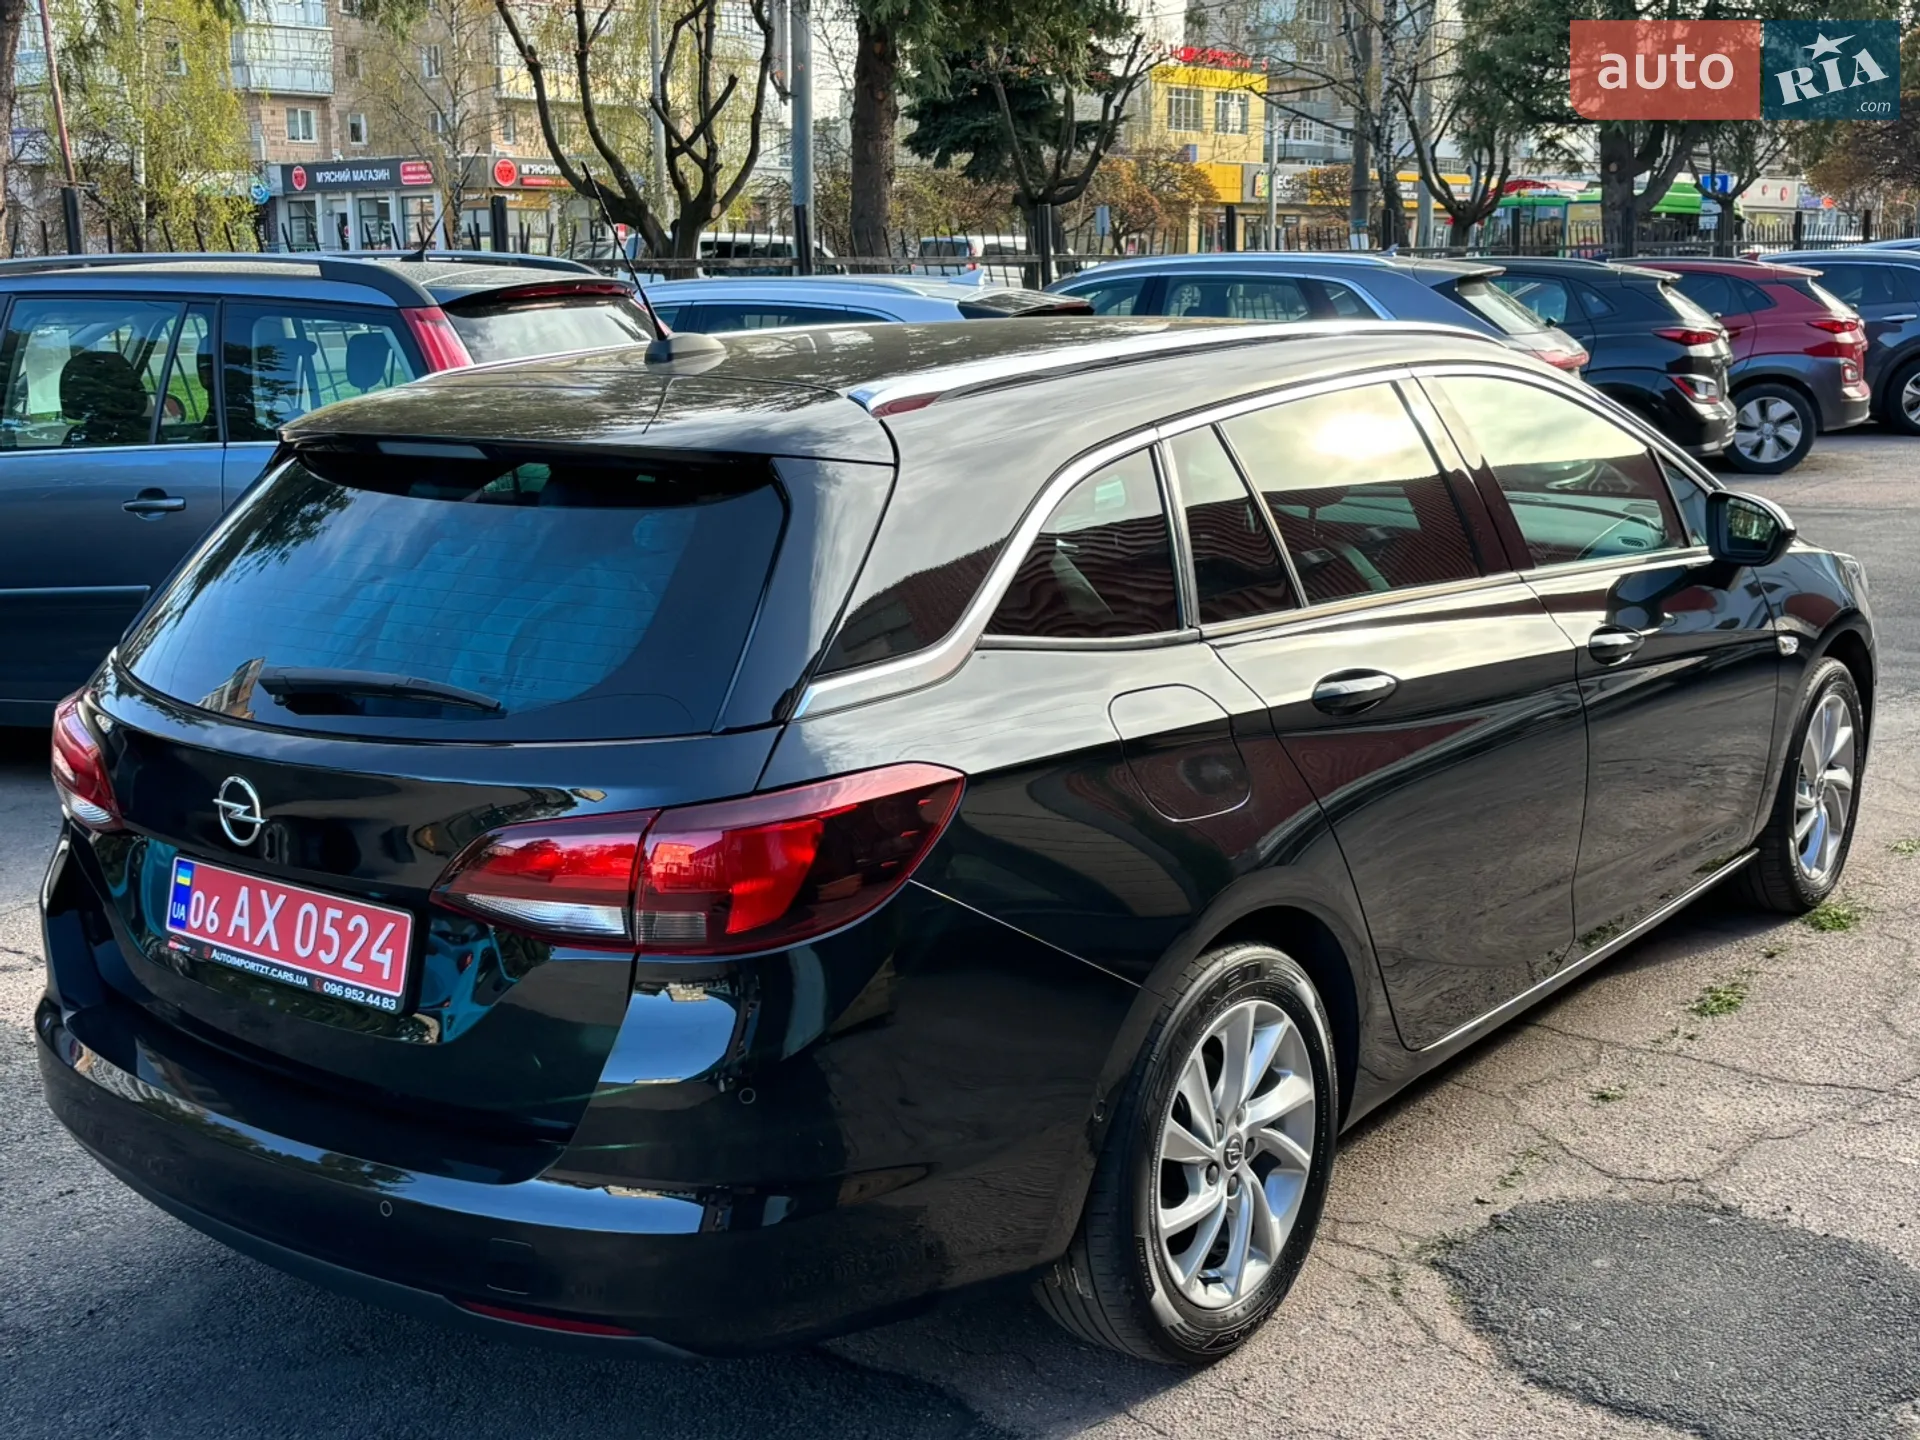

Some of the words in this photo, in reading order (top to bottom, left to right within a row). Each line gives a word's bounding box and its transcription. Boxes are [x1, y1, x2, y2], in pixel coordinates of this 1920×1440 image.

[316, 168, 351, 183] М'ЯСНИЙ
[352, 168, 390, 182] МАГАЗИН
[521, 164, 562, 175] М'ЯСНИ
[172, 901, 186, 921] UA
[189, 890, 220, 934] 06
[226, 885, 287, 952] AX
[294, 902, 396, 980] 0524
[323, 981, 344, 996] 096
[344, 987, 365, 1002] 952
[366, 994, 380, 1006] 44
[381, 997, 396, 1011] 83
